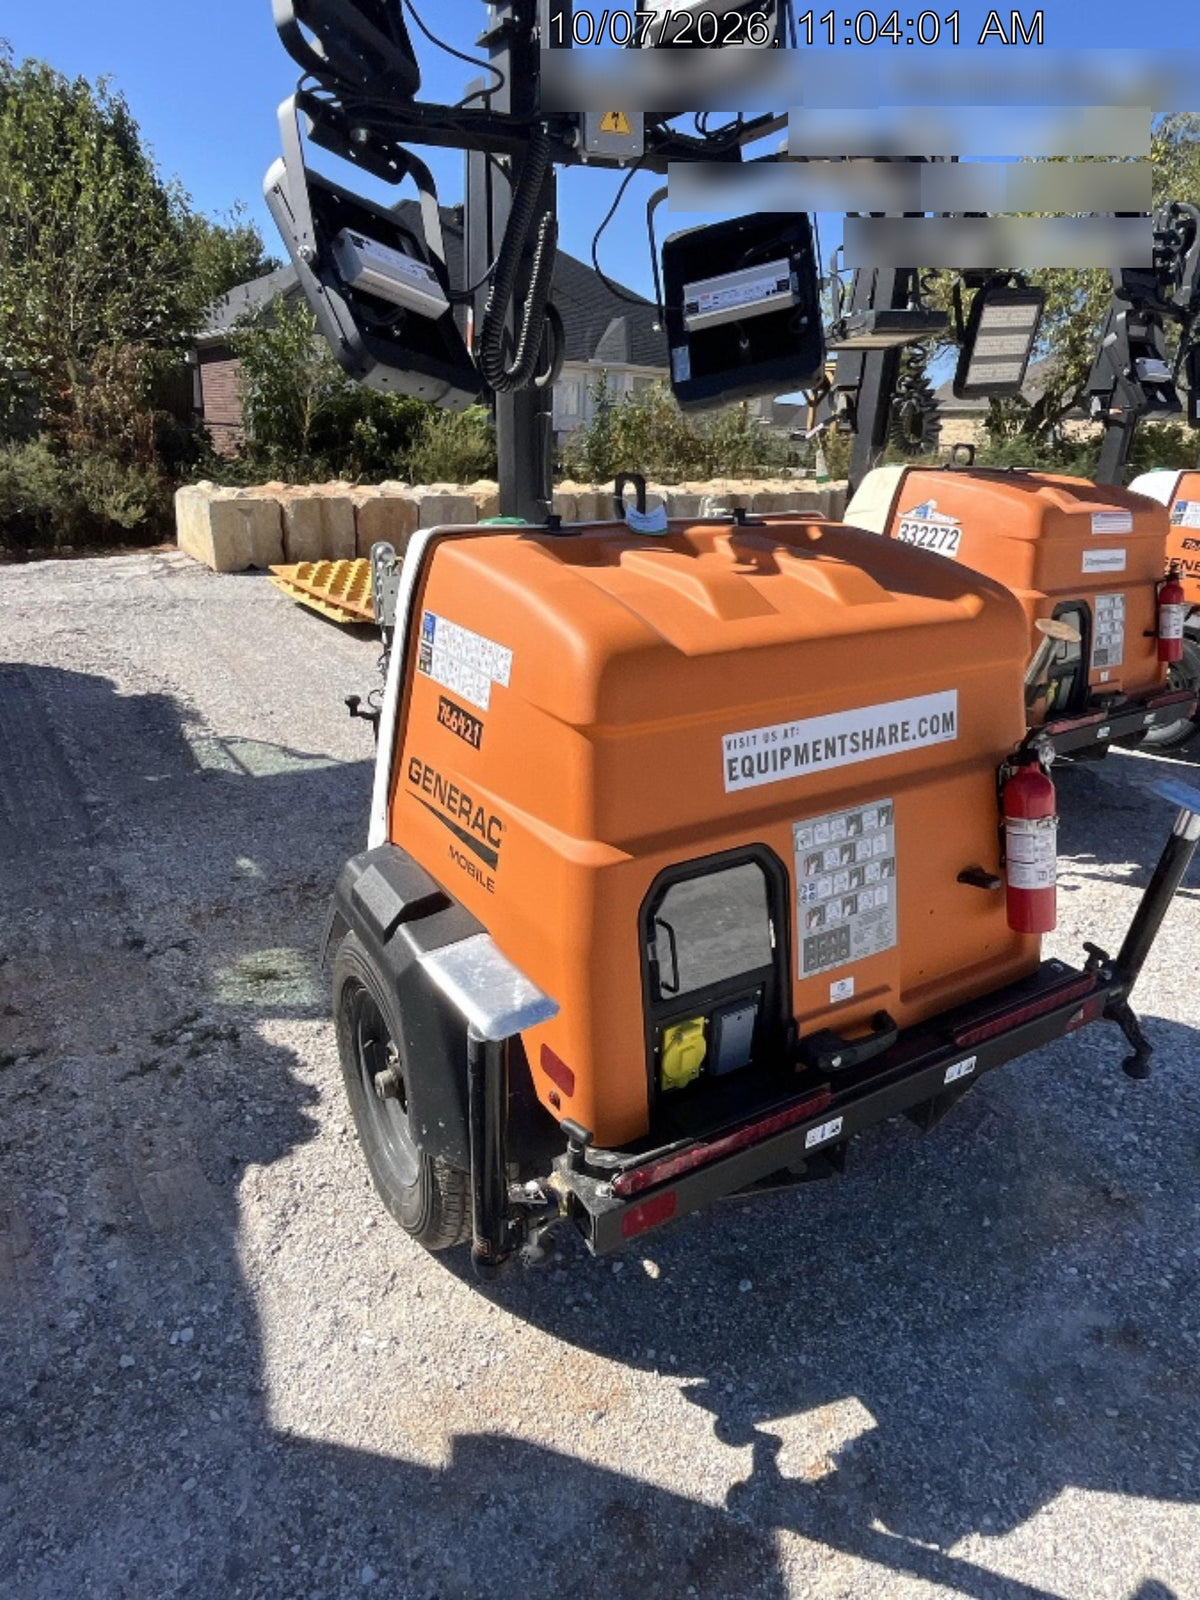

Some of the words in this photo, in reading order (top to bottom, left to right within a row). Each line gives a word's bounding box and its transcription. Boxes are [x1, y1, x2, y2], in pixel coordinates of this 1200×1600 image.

[901, 523, 959, 550] 332272
[725, 735, 757, 751] VISIT
[762, 730, 778, 744] US
[783, 727, 799, 740] AT:
[727, 710, 955, 782] EQUIPMENTSHARE.COM
[408, 756, 503, 849] GENERAC
[449, 844, 495, 895] MOBILE
